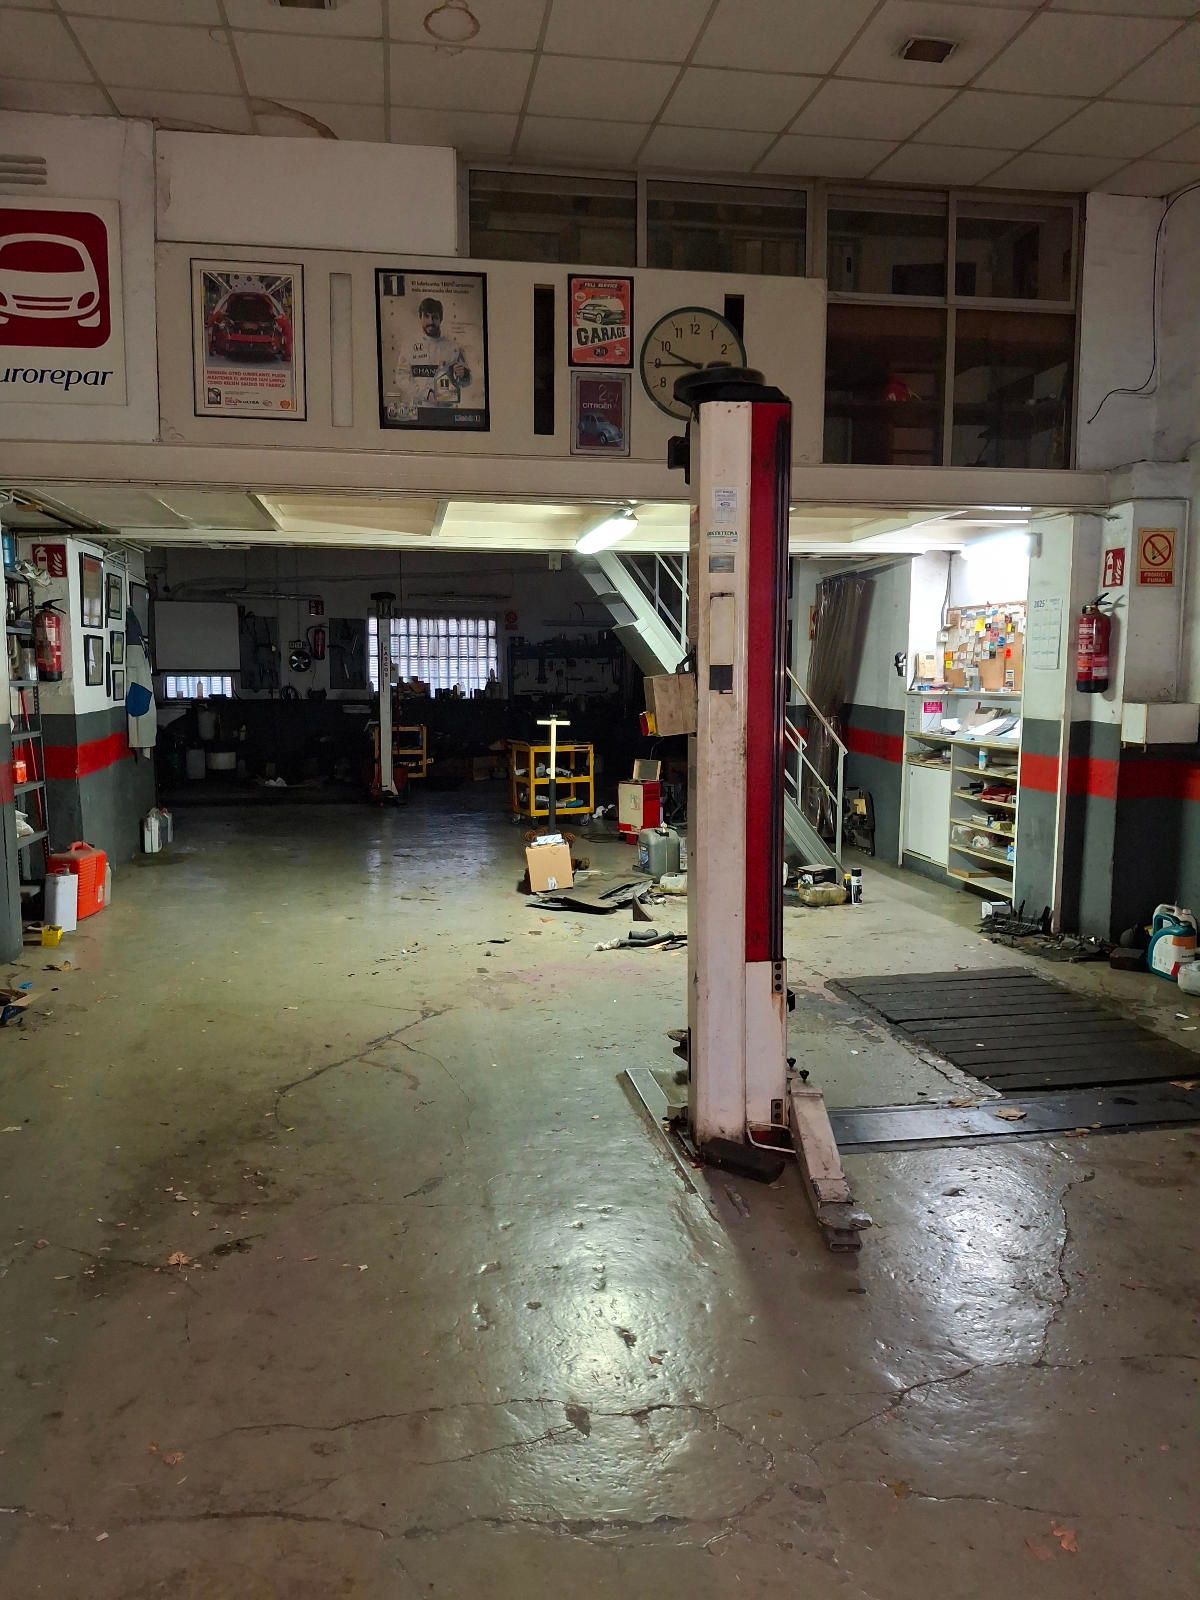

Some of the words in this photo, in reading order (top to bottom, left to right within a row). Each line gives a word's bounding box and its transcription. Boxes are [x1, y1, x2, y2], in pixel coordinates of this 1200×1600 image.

[675, 327, 683, 339] 11
[690, 323, 701, 335] 12
[710, 329, 714, 340] 1
[576, 327, 626, 345] GARAGE
[661, 341, 671, 352] 10
[720, 343, 728, 355] 2
[654, 358, 661, 368] 9
[660, 377, 667, 388] 8
